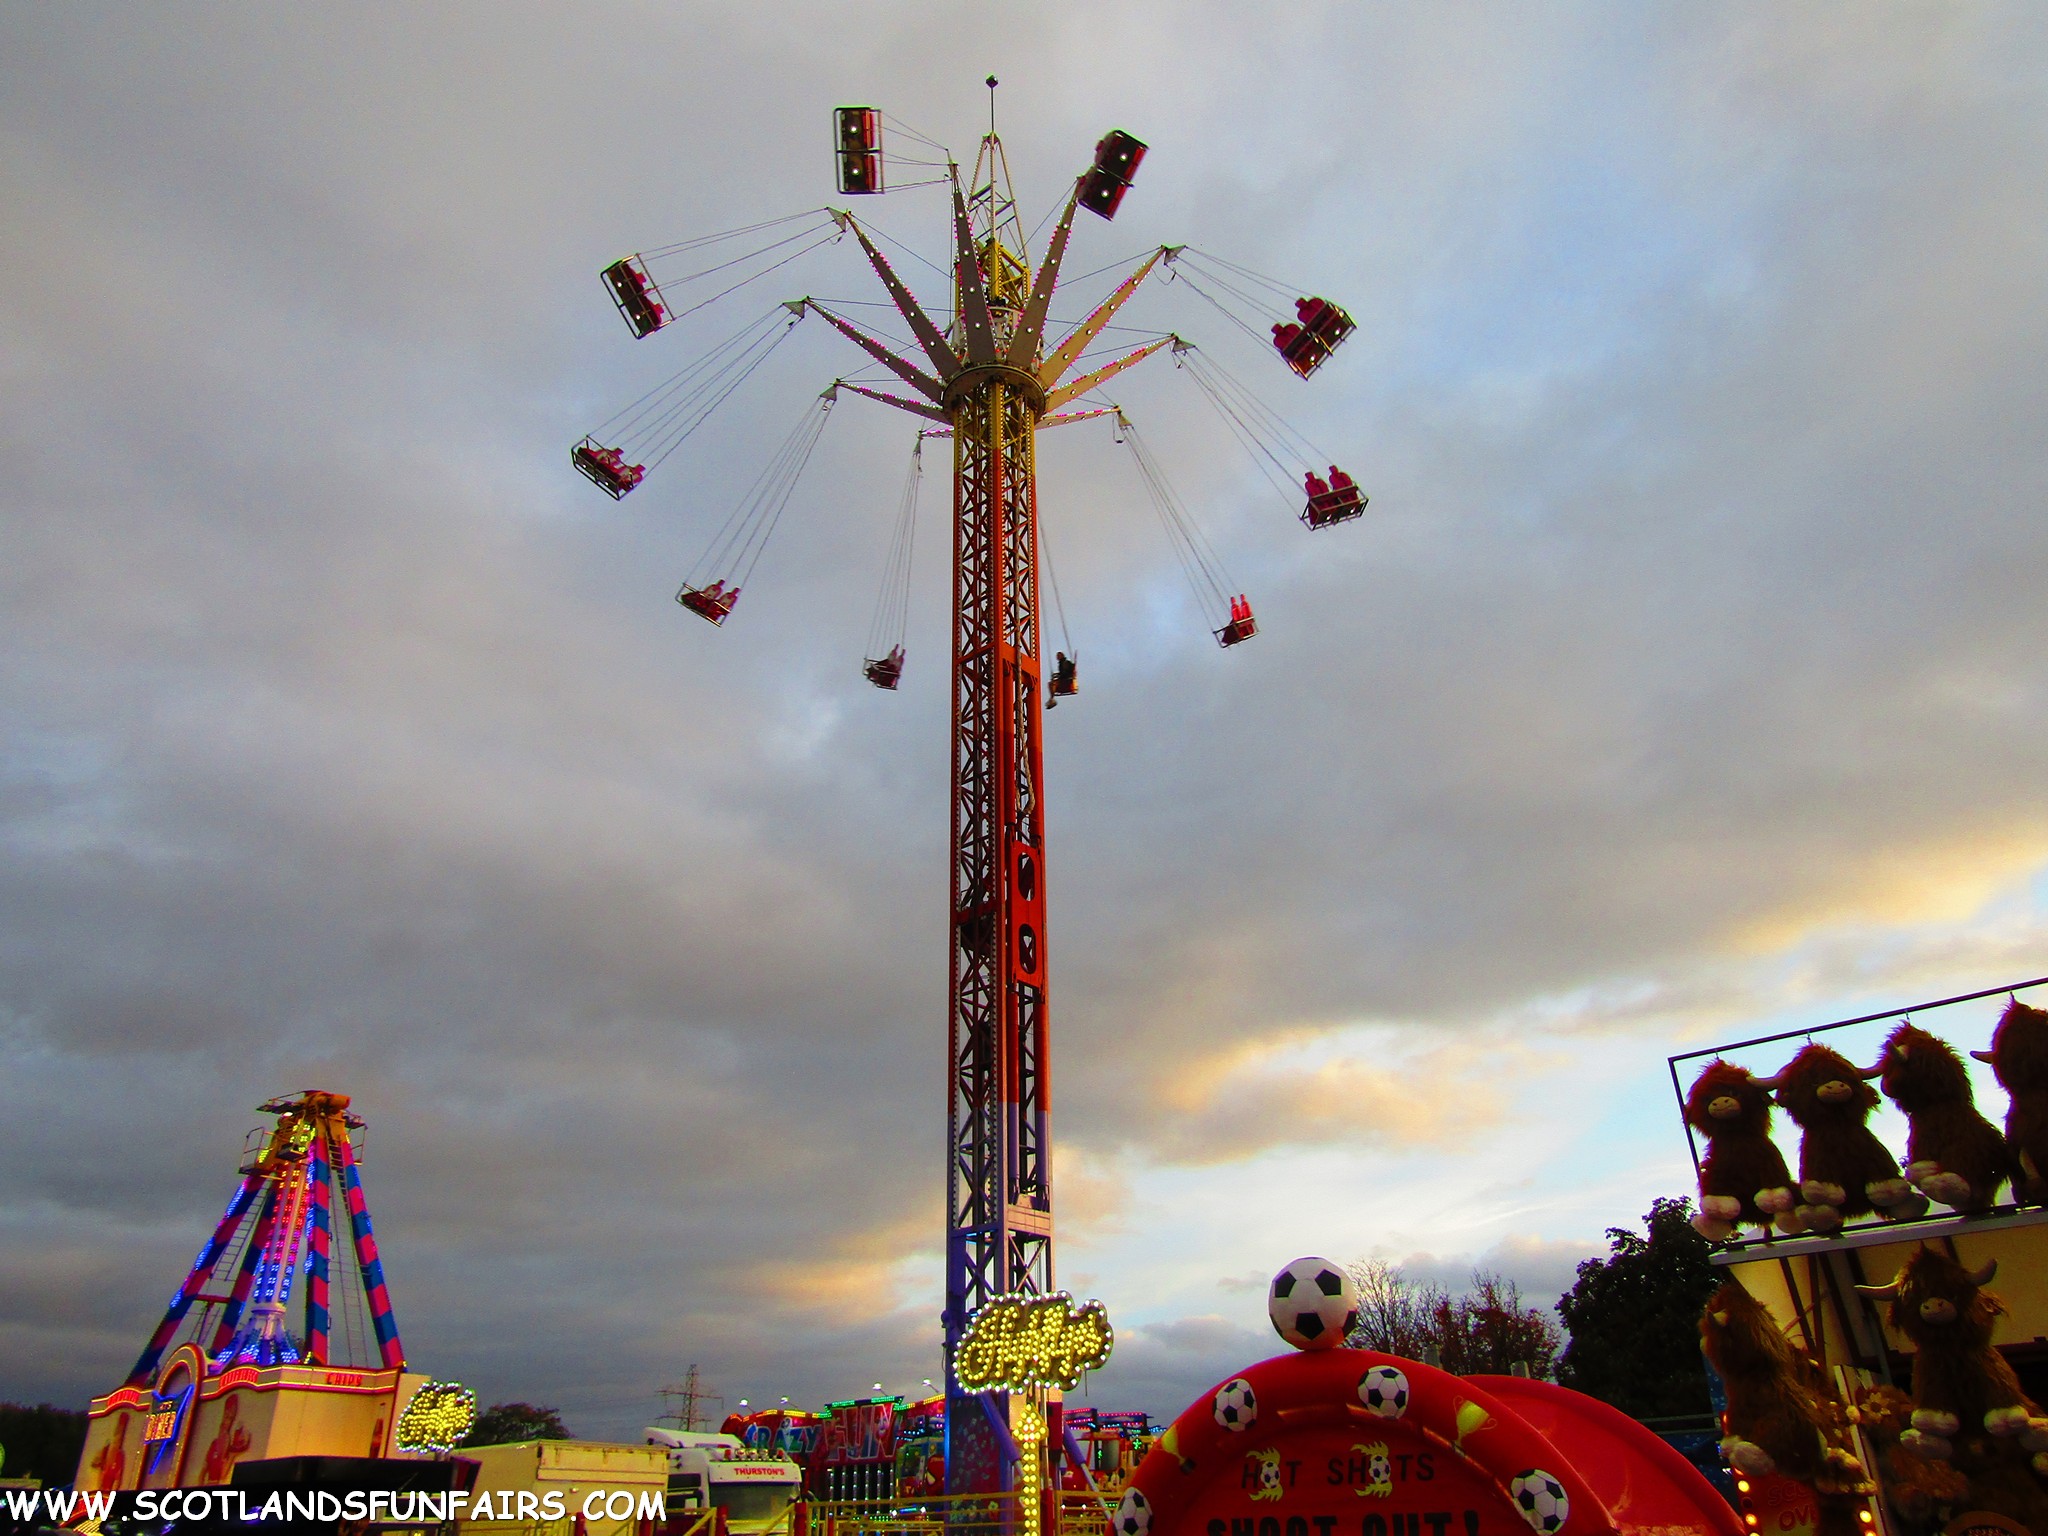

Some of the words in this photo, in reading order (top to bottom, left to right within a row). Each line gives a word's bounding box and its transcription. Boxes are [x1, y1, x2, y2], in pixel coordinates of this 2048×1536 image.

[326, 1371, 363, 1386] CHIPS
[744, 1420, 822, 1453] CRAZY
[824, 1402, 898, 1462] FUN
[733, 1467, 786, 1476] THURSTON'S
